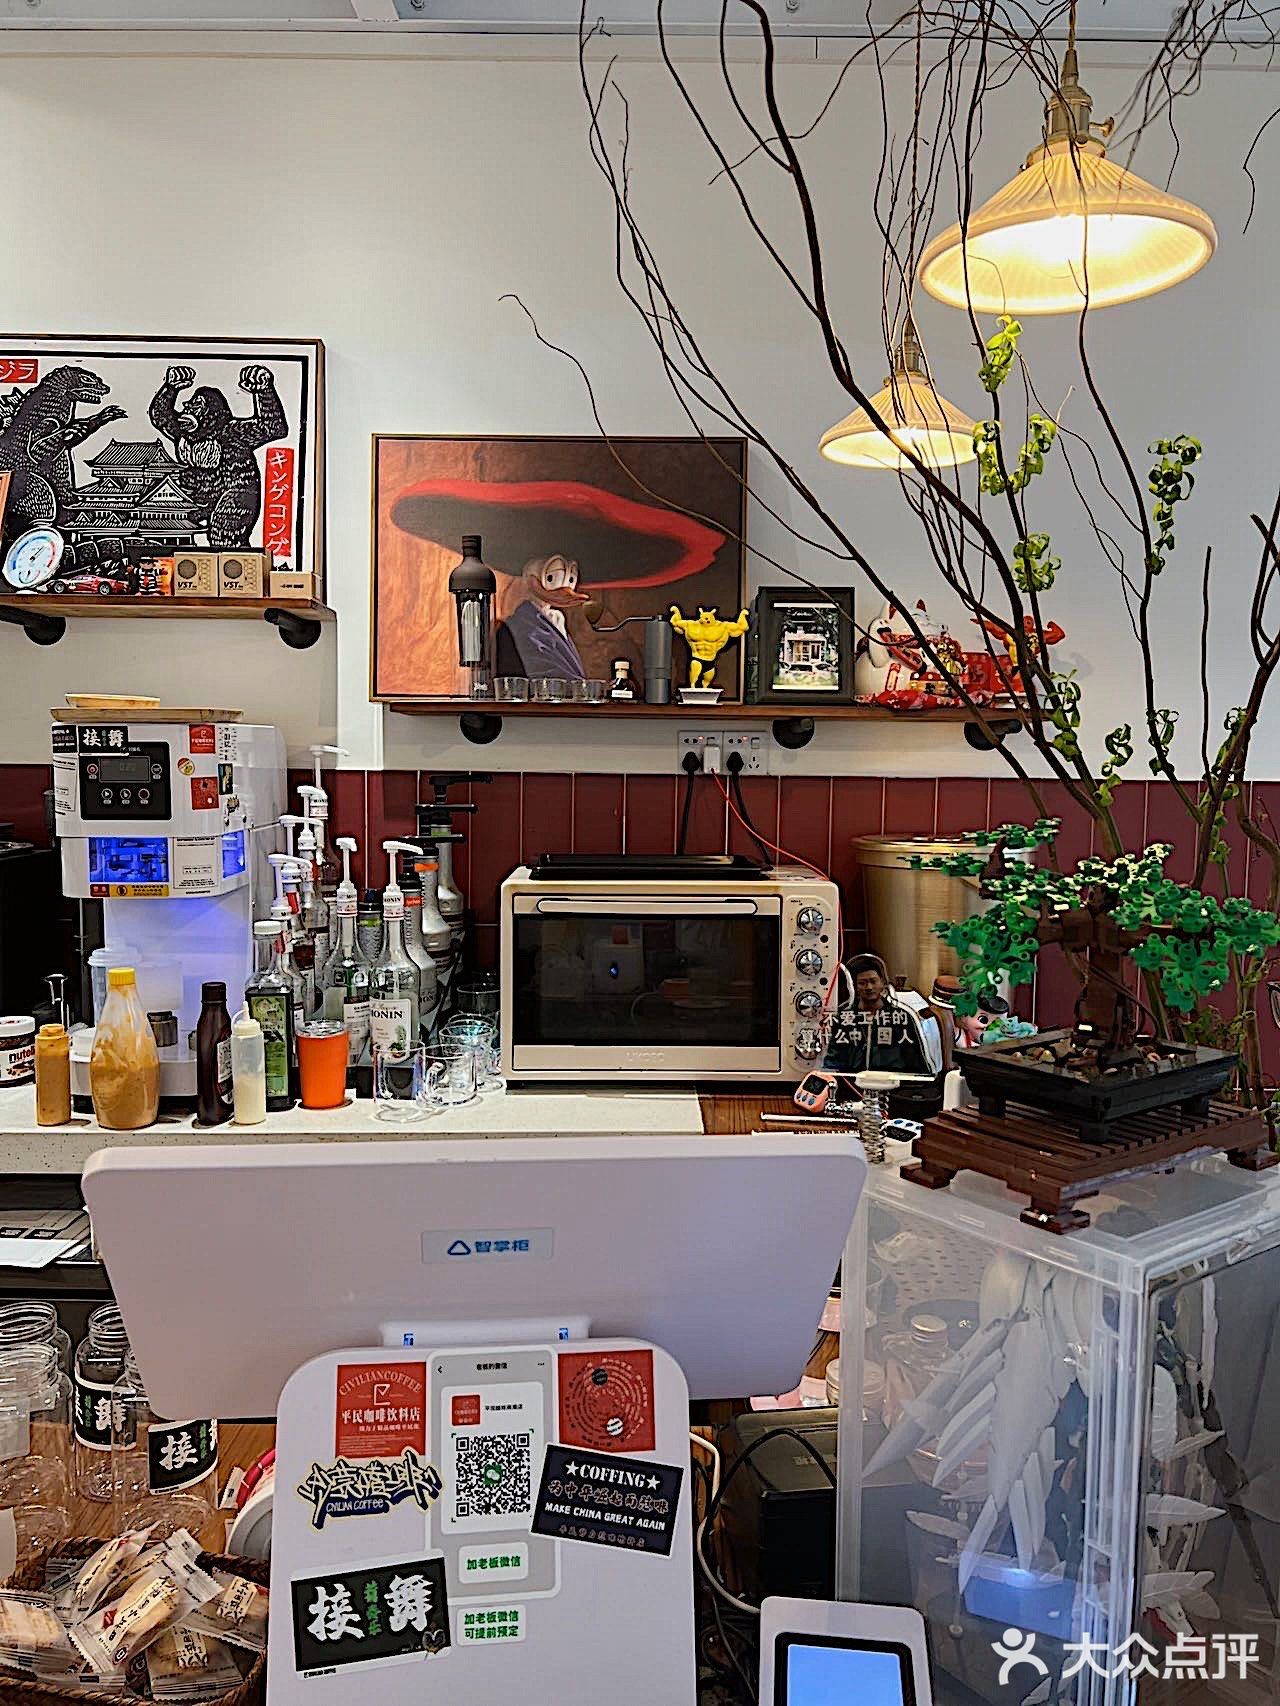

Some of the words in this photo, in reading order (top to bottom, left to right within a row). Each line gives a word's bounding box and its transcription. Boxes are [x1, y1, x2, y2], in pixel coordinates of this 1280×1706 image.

[823, 1009, 908, 1027] 不爱工作的
[475, 1239, 530, 1253] 智掌柜
[341, 1406, 421, 1425] 平民咖啡饮料店
[579, 1463, 646, 1489] COFFING
[544, 1502, 572, 1515] MAKE
[573, 1506, 602, 1521] CHINA
[604, 1512, 633, 1526] GREAT
[635, 1517, 666, 1531] AGAIN
[466, 1555, 521, 1571] 加老板微信
[307, 1583, 366, 1642] 接
[464, 1609, 519, 1625] 加老板微信
[464, 1625, 519, 1640] 可提前预定
